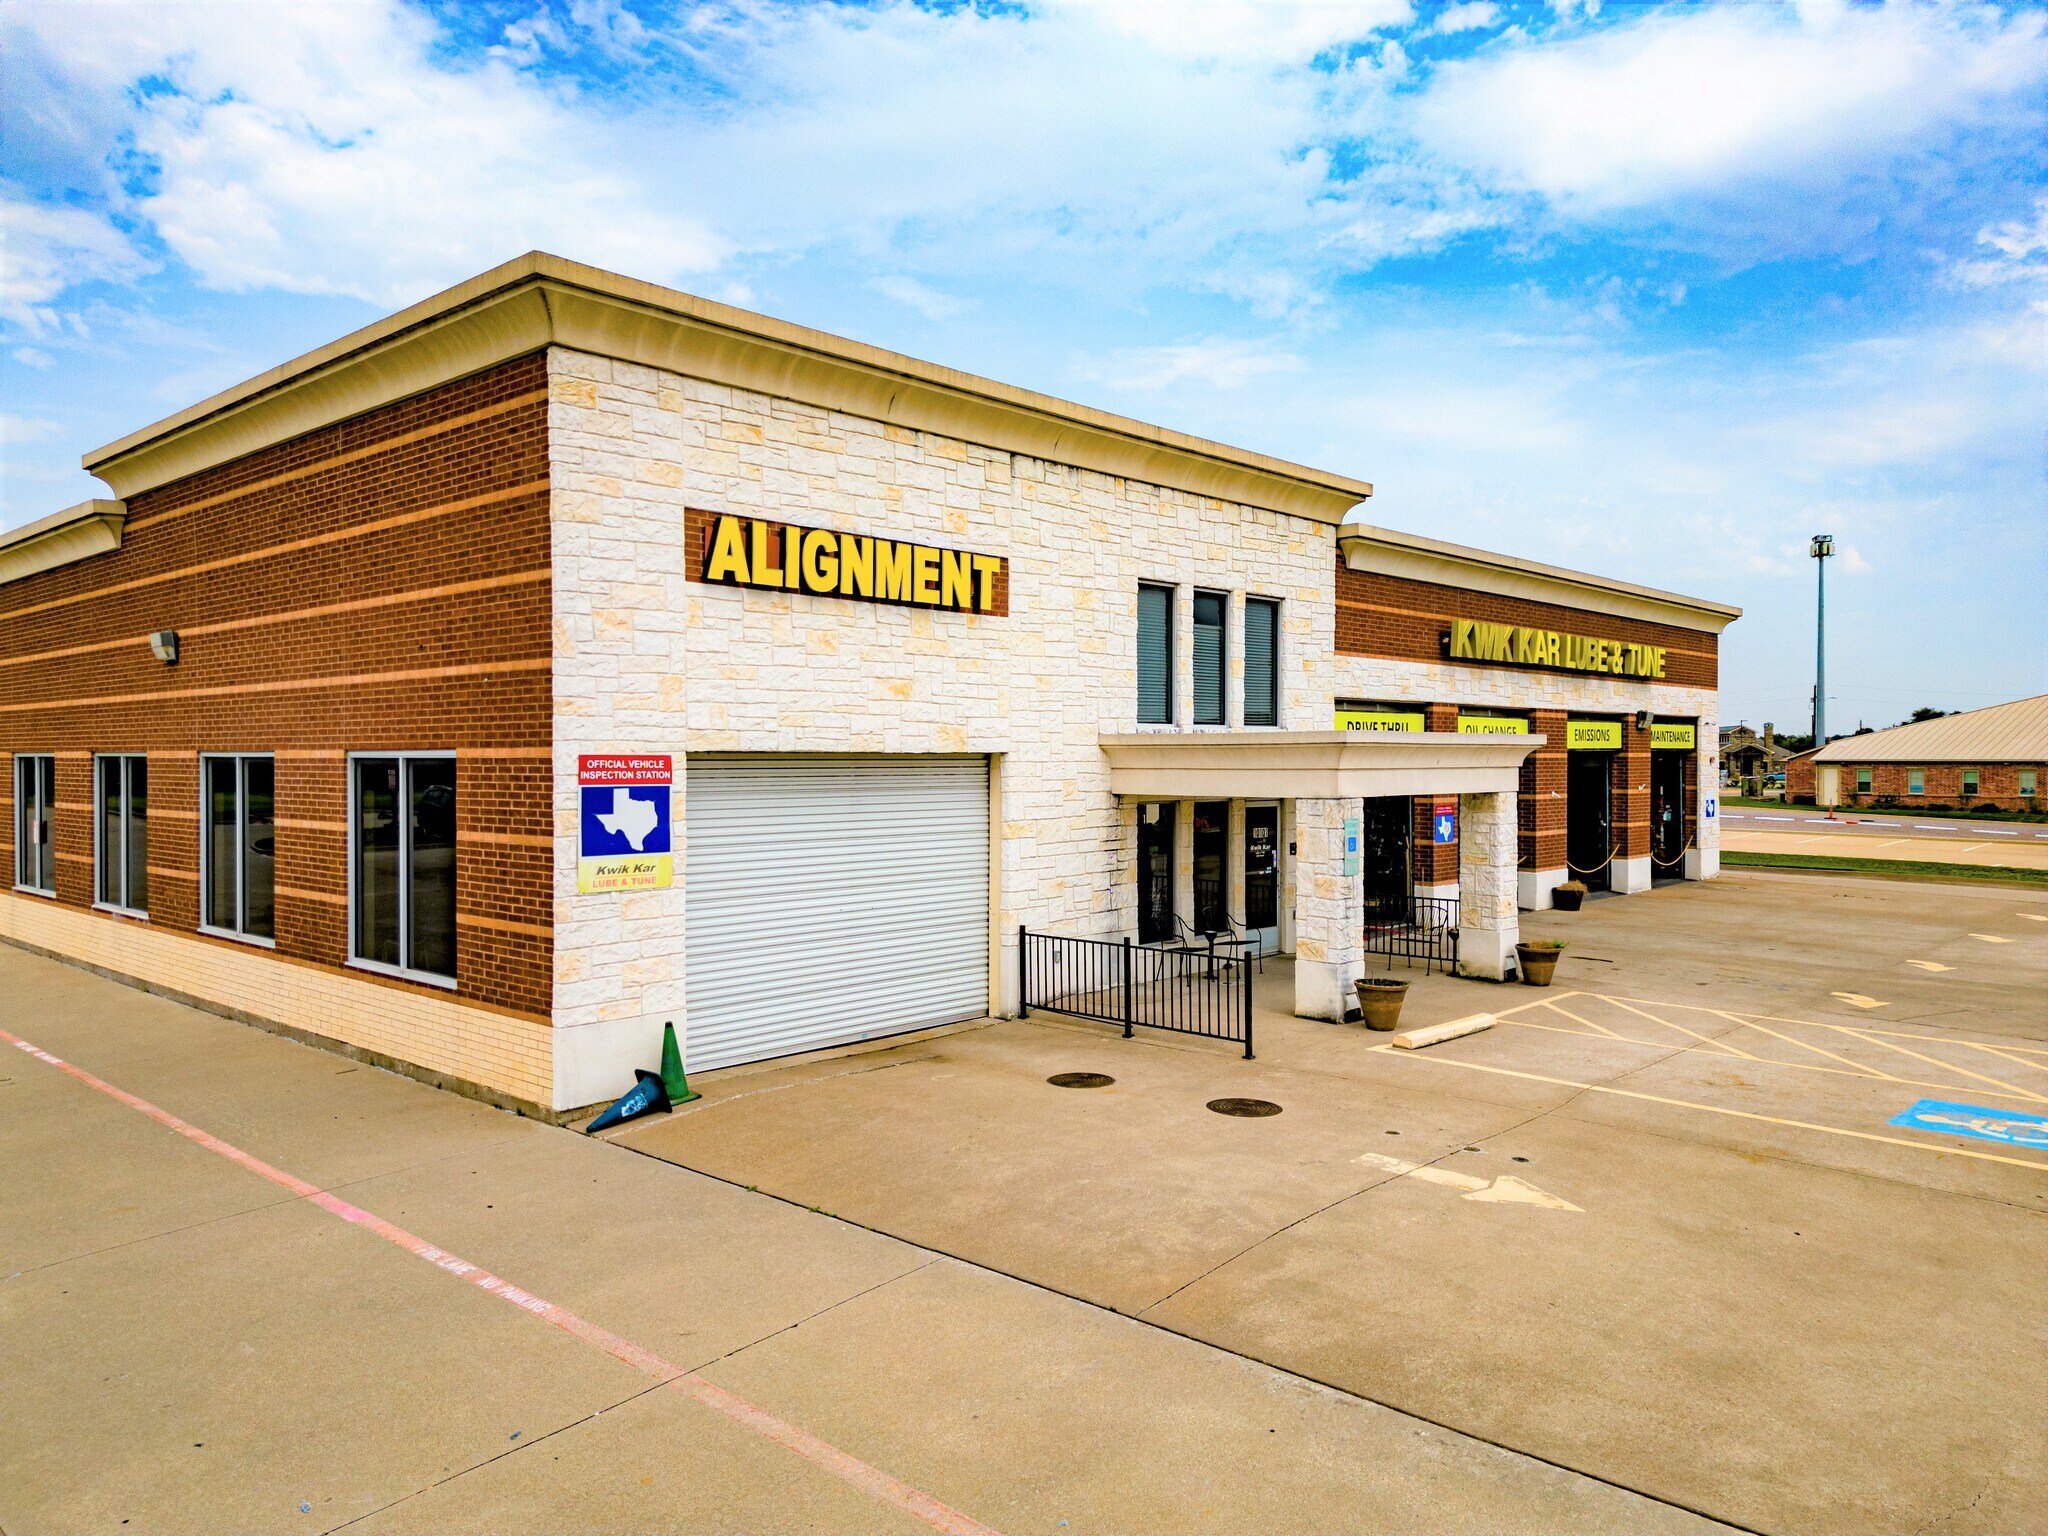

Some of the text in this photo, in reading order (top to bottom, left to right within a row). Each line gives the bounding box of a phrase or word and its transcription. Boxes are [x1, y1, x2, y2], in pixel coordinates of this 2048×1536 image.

[706, 515, 1001, 611] ALIGNMENT
[1450, 619, 1666, 678] KWIK KAR LUBE & TUNE
[1574, 728, 1611, 742] EMISSIONS
[1650, 730, 1691, 742] MAINTENANCE
[586, 759, 665, 769] OFFICIAL VEHICLE
[580, 770, 671, 780] INSPECTION STATION
[596, 863, 657, 876] Kwik Kar
[592, 876, 657, 889] LUBE & TUNE
[475, 1275, 502, 1289] NO
[494, 1286, 552, 1313] PARKING
